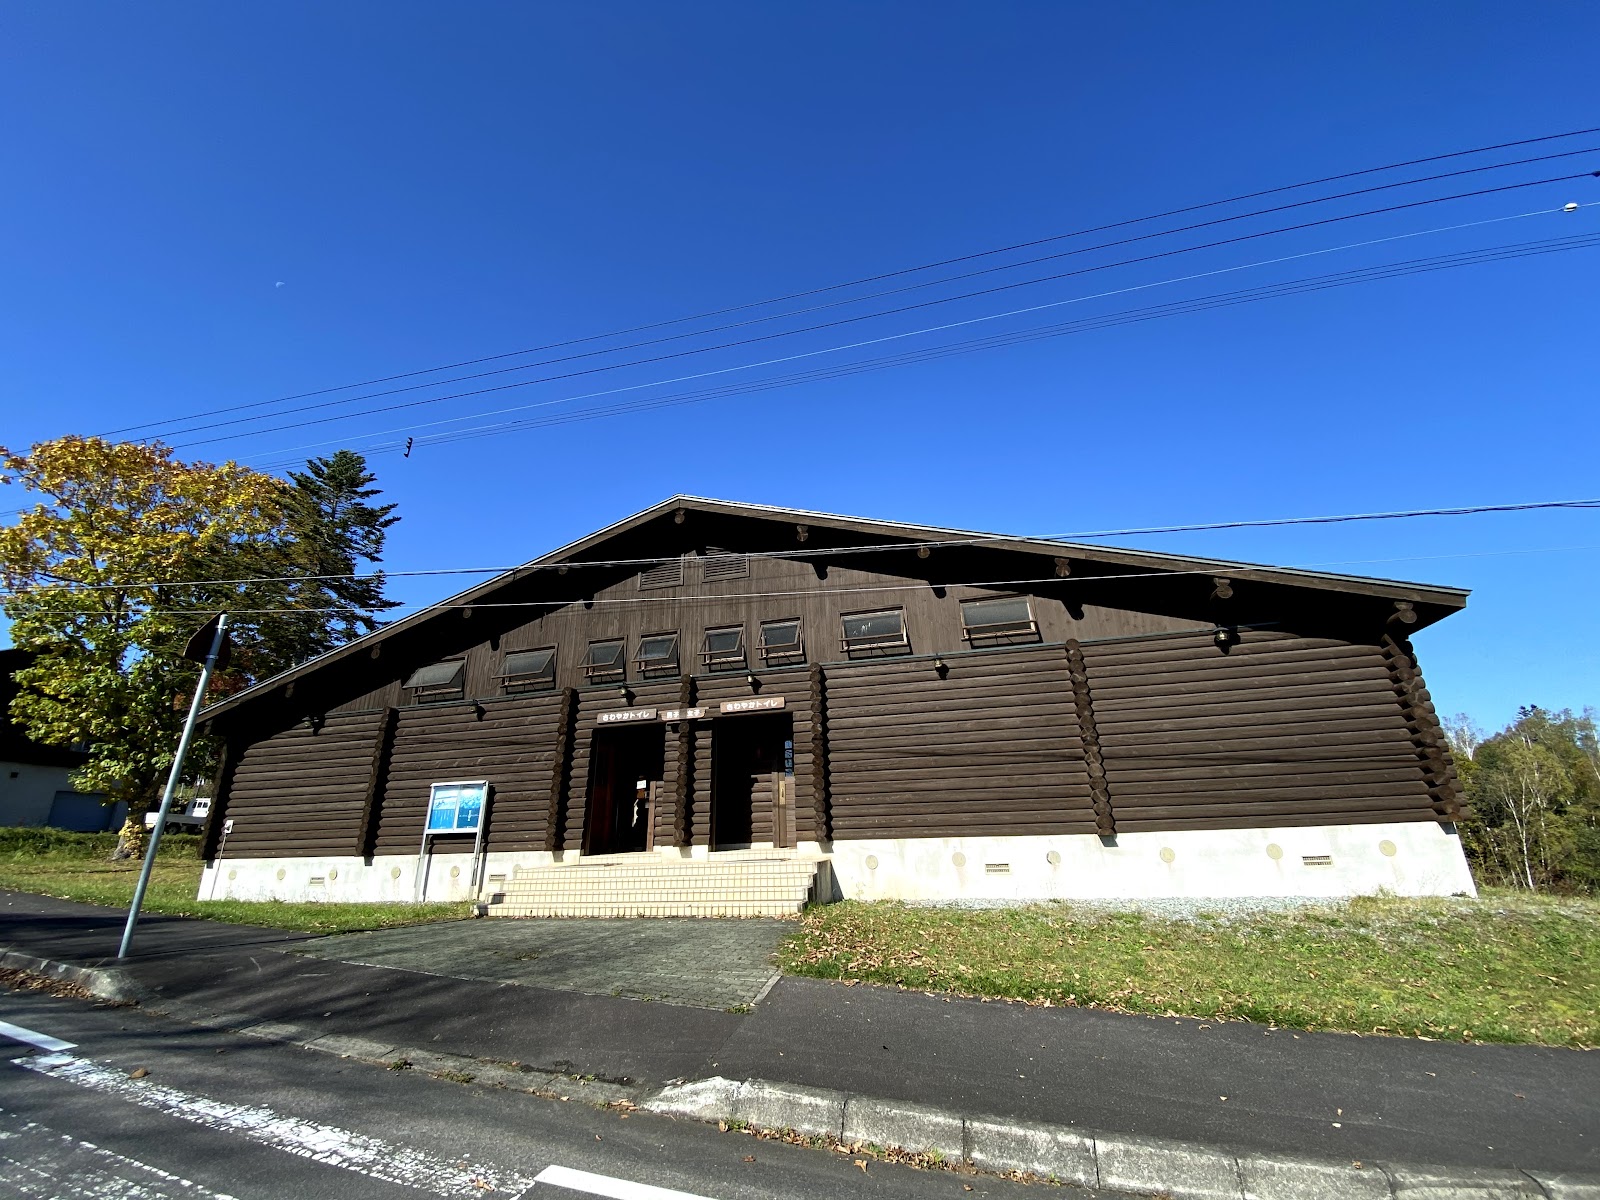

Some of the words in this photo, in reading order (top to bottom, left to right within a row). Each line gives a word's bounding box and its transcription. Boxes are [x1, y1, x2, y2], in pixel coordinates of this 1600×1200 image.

[726, 699, 778, 711] さわやかトイレ
[602, 710, 650, 722] さわやかトイレ
